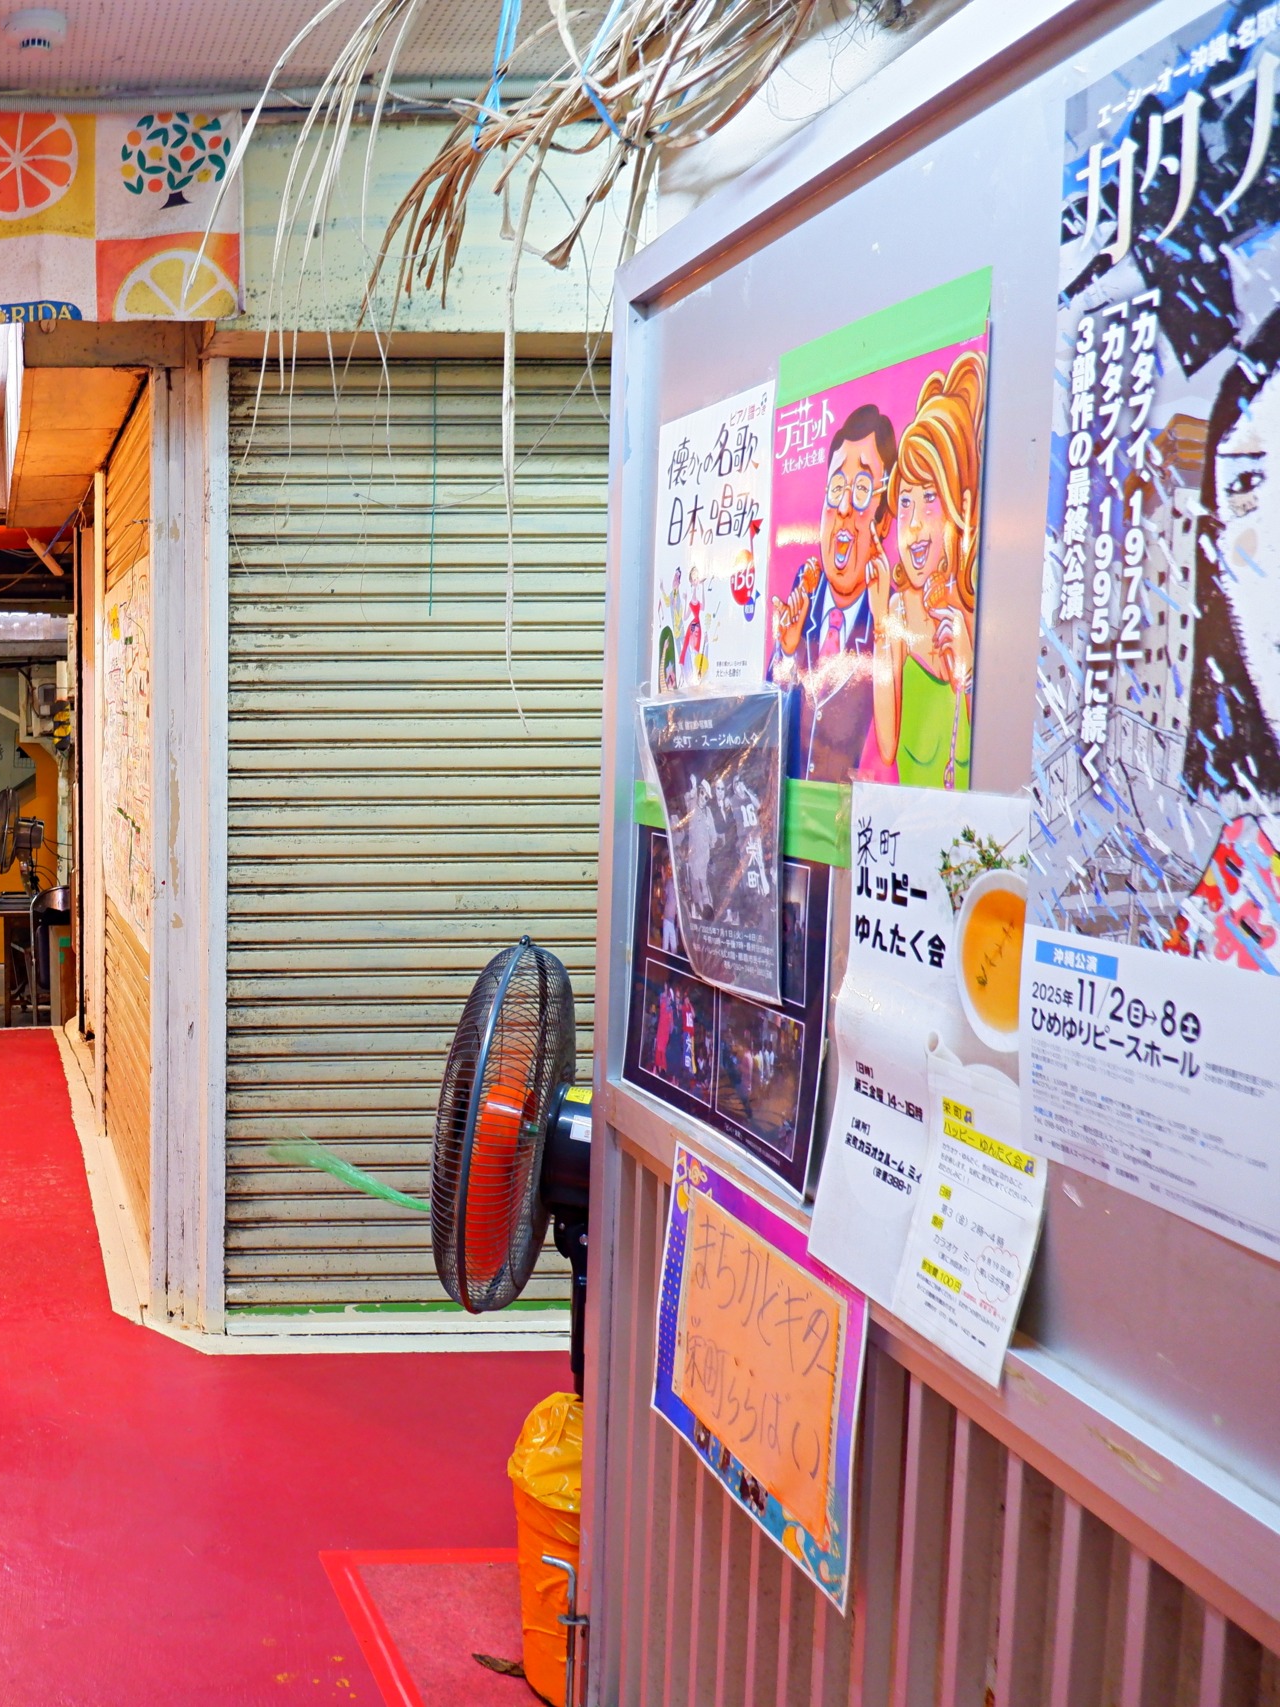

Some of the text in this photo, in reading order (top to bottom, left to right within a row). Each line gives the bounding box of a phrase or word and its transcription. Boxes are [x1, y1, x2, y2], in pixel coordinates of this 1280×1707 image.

[730, 403, 767, 427] ピアノ譜つき
[667, 423, 760, 490] 懐かしの名歌
[782, 447, 826, 475] 大ヒット大全集
[1060, 317, 1097, 620] 3部作の最終公演
[667, 483, 761, 546] 日本の唱歌
[857, 816, 901, 867] 栄町
[857, 866, 928, 908] ハッピー
[854, 914, 946, 969] ゆんたく会
[1053, 948, 1098, 973] 沖縄公演
[1032, 1007, 1200, 1079] ひめゆりピースホール
[854, 1078, 884, 1103] 第三金曜
[980, 1138, 1023, 1171] ゆんたく会
[933, 1234, 959, 1255] カラオケ
[694, 1215, 834, 1377] まちかどギター
[685, 1315, 820, 1480] 栄町ららばい
